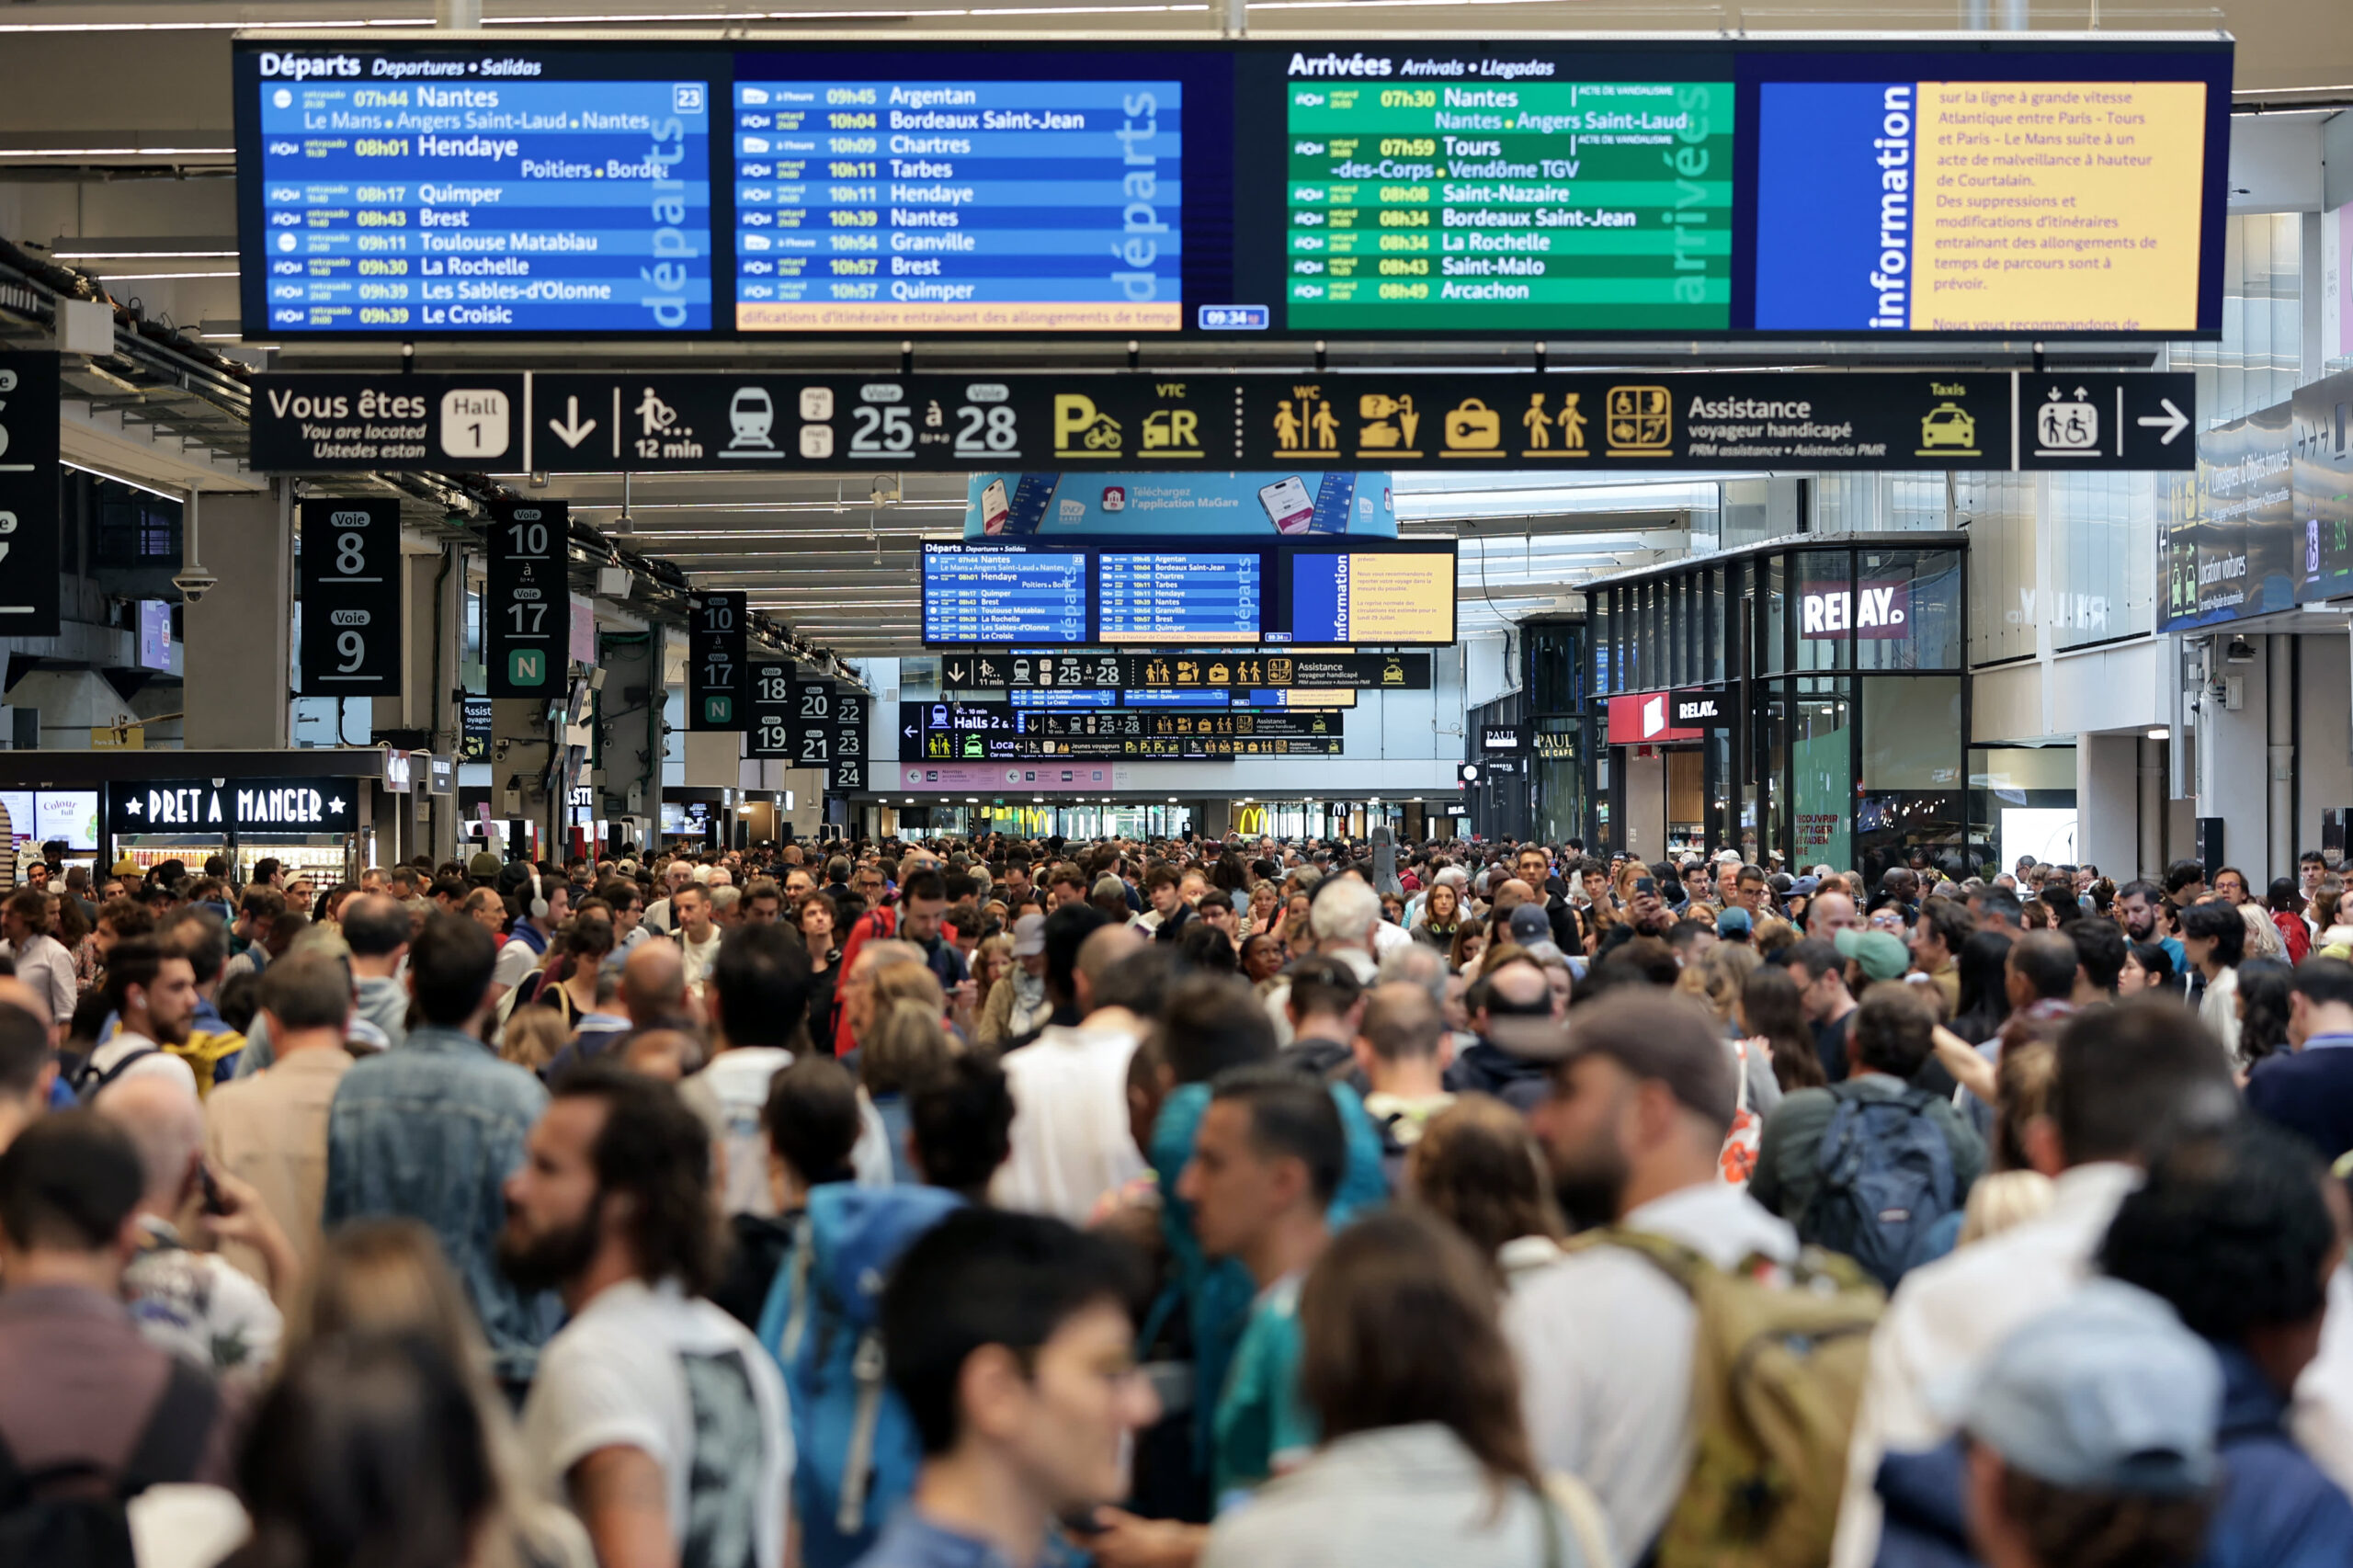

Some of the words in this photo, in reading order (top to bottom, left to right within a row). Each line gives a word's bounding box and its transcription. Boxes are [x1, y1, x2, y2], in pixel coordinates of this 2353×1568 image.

[259, 52, 361, 80] Départs
[372, 60, 464, 78] Departures
[482, 60, 541, 75] Salidas
[1288, 54, 1392, 75] Arrivées
[1401, 60, 1464, 76] Arrivals
[1481, 60, 1554, 79] Llegadas
[354, 90, 408, 108] 07h44
[417, 87, 499, 108] Nantes
[678, 91, 700, 107] 23
[890, 87, 975, 108] Argentan
[1380, 90, 1436, 107] 07h30
[1445, 88, 1518, 108] Nantes
[304, 113, 326, 129] Le
[331, 113, 381, 129] Mans
[397, 113, 460, 133] Angers
[465, 112, 567, 129] Saint-Laud
[582, 112, 649, 129] Nantes
[890, 111, 978, 129] Bordeaux
[983, 111, 1085, 130] Saint-Jean
[1435, 113, 1502, 130] Nantes
[1517, 113, 1581, 133] Angers
[1586, 112, 1687, 130] Saint-Laud
[355, 140, 409, 156] 08h01
[418, 136, 518, 160] Hendaye
[1380, 140, 1435, 155] 07h59
[1444, 137, 1501, 156] Tours
[1937, 154, 1966, 165] acte
[1972, 153, 1989, 165] de
[1993, 153, 2080, 165] malveillance
[2085, 153, 2093, 165] à
[2097, 154, 2152, 165] hauteur
[521, 162, 592, 178] Poitiers
[890, 160, 952, 178] Tarbes
[1331, 162, 1434, 180] -des-Corps
[1448, 161, 1537, 178] Vendôme
[1541, 162, 1579, 178] TGV
[1937, 174, 1954, 187] de
[1958, 174, 2034, 187] Courtalain.
[356, 187, 405, 203] 08h17
[419, 186, 502, 207] Quimper
[891, 185, 973, 207] Hendaye
[1110, 92, 1169, 301] départs
[1443, 186, 1569, 203] Saint-Nazaire
[1662, 87, 1711, 303] arrivées
[1870, 86, 1910, 329] information
[358, 210, 406, 226] 08h43
[420, 210, 469, 226] Brest
[641, 117, 698, 328] départs
[891, 210, 958, 226] Nantes
[1380, 211, 1429, 226] 08h34
[1443, 210, 1531, 227] Bordeaux
[1536, 210, 1636, 228] Saint-Jean
[358, 235, 406, 251] 09h11
[421, 233, 506, 251] Toulouse
[510, 233, 597, 251] Matabiau
[891, 233, 975, 252] Granville
[1379, 235, 1429, 251] 08h34
[1442, 234, 1465, 251] La
[1470, 233, 1551, 251] Rochelle
[358, 259, 408, 276] 09h30
[421, 259, 443, 276] La
[449, 258, 529, 276] Rochelle
[892, 257, 940, 275] Brest
[1379, 259, 1428, 275] 08h43
[1442, 258, 1544, 276] Saint-Malo
[359, 284, 408, 300] 09h39
[422, 282, 453, 300] Les
[458, 281, 611, 300] Sables-d'Olonne
[1441, 282, 1529, 300] Arcachon
[359, 308, 409, 324] 09h39
[423, 307, 445, 324] Le
[449, 306, 512, 324] Croisic
[866, 386, 898, 399] Voie
[972, 386, 1004, 399] Voie
[1156, 384, 1186, 398] VTC
[1294, 386, 1320, 399] WC
[1930, 383, 1965, 396] Taxis
[268, 391, 348, 418] Vous
[358, 389, 426, 418] êtes
[455, 398, 497, 415] Hall
[1688, 397, 1811, 418] Assistance
[926, 401, 942, 426] à
[301, 425, 330, 438] You
[334, 427, 361, 438] are
[365, 424, 426, 438] located
[468, 424, 483, 449] 1
[851, 406, 914, 450] 25
[954, 406, 1017, 450] 28
[1688, 425, 1763, 441] voyageur
[1767, 422, 1851, 441] handicapé
[313, 443, 378, 459] Ustedes
[381, 443, 426, 458] estan
[635, 440, 659, 458] 12
[664, 440, 703, 458] min
[2212, 463, 2239, 496] Consignes
[2246, 452, 2265, 489] Objets
[2266, 443, 2289, 476] trouvés
[1133, 486, 1190, 497] Téléchargez
[1199, 497, 1238, 507] MaGare
[336, 513, 366, 526] Voie
[507, 524, 548, 553] 10
[2335, 518, 2347, 551] BUS
[335, 533, 365, 574] 8
[926, 544, 961, 553] Départs
[2200, 555, 2222, 585] Location
[2222, 551, 2245, 580] voitures
[336, 610, 366, 624] Voie
[507, 603, 548, 633] 17
[336, 631, 365, 673] 9
[517, 657, 537, 678] N
[1059, 666, 1081, 682] 25
[1097, 666, 1119, 682] 28
[1298, 663, 1343, 671] Assistance
[757, 678, 786, 699] 18
[801, 696, 827, 715] 20
[838, 706, 858, 722] 22
[955, 717, 987, 728] Halls
[992, 717, 999, 728] 2
[757, 727, 786, 748] 19
[838, 737, 858, 753] 23
[1537, 734, 1574, 748] PAUL
[801, 739, 827, 758] 21
[837, 769, 858, 784] 24
[149, 789, 201, 823] PRET
[238, 789, 322, 822] MANGER
